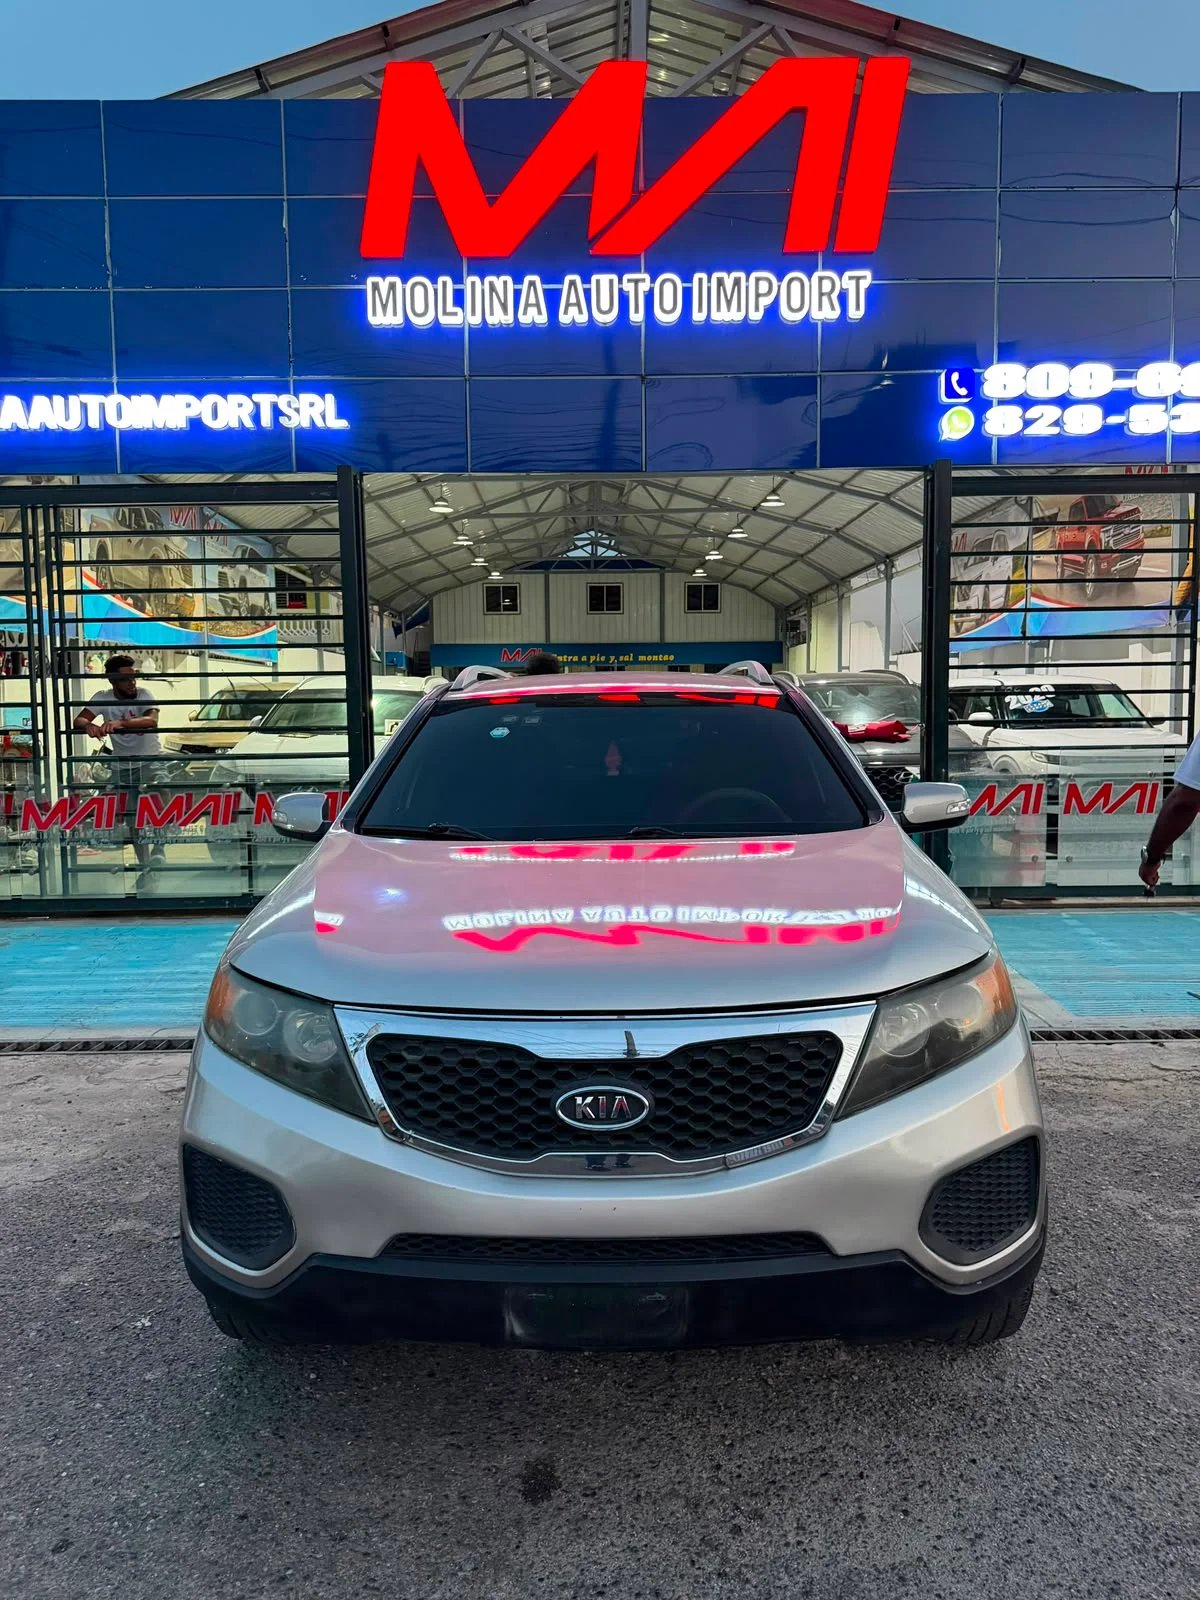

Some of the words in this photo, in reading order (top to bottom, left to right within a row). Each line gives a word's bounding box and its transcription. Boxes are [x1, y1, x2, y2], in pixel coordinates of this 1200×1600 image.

[360, 57, 911, 259] MAI
[366, 274, 549, 327] MOLINA
[558, 272, 682, 326] AUTO
[691, 269, 873, 325] IMPORT
[552, 654, 578, 662] ntra
[638, 654, 675, 662] montao
[21, 796, 117, 832] MAI
[135, 792, 234, 829] MAI
[1063, 781, 1160, 816] MAI
[575, 1096, 631, 1120] KIA
